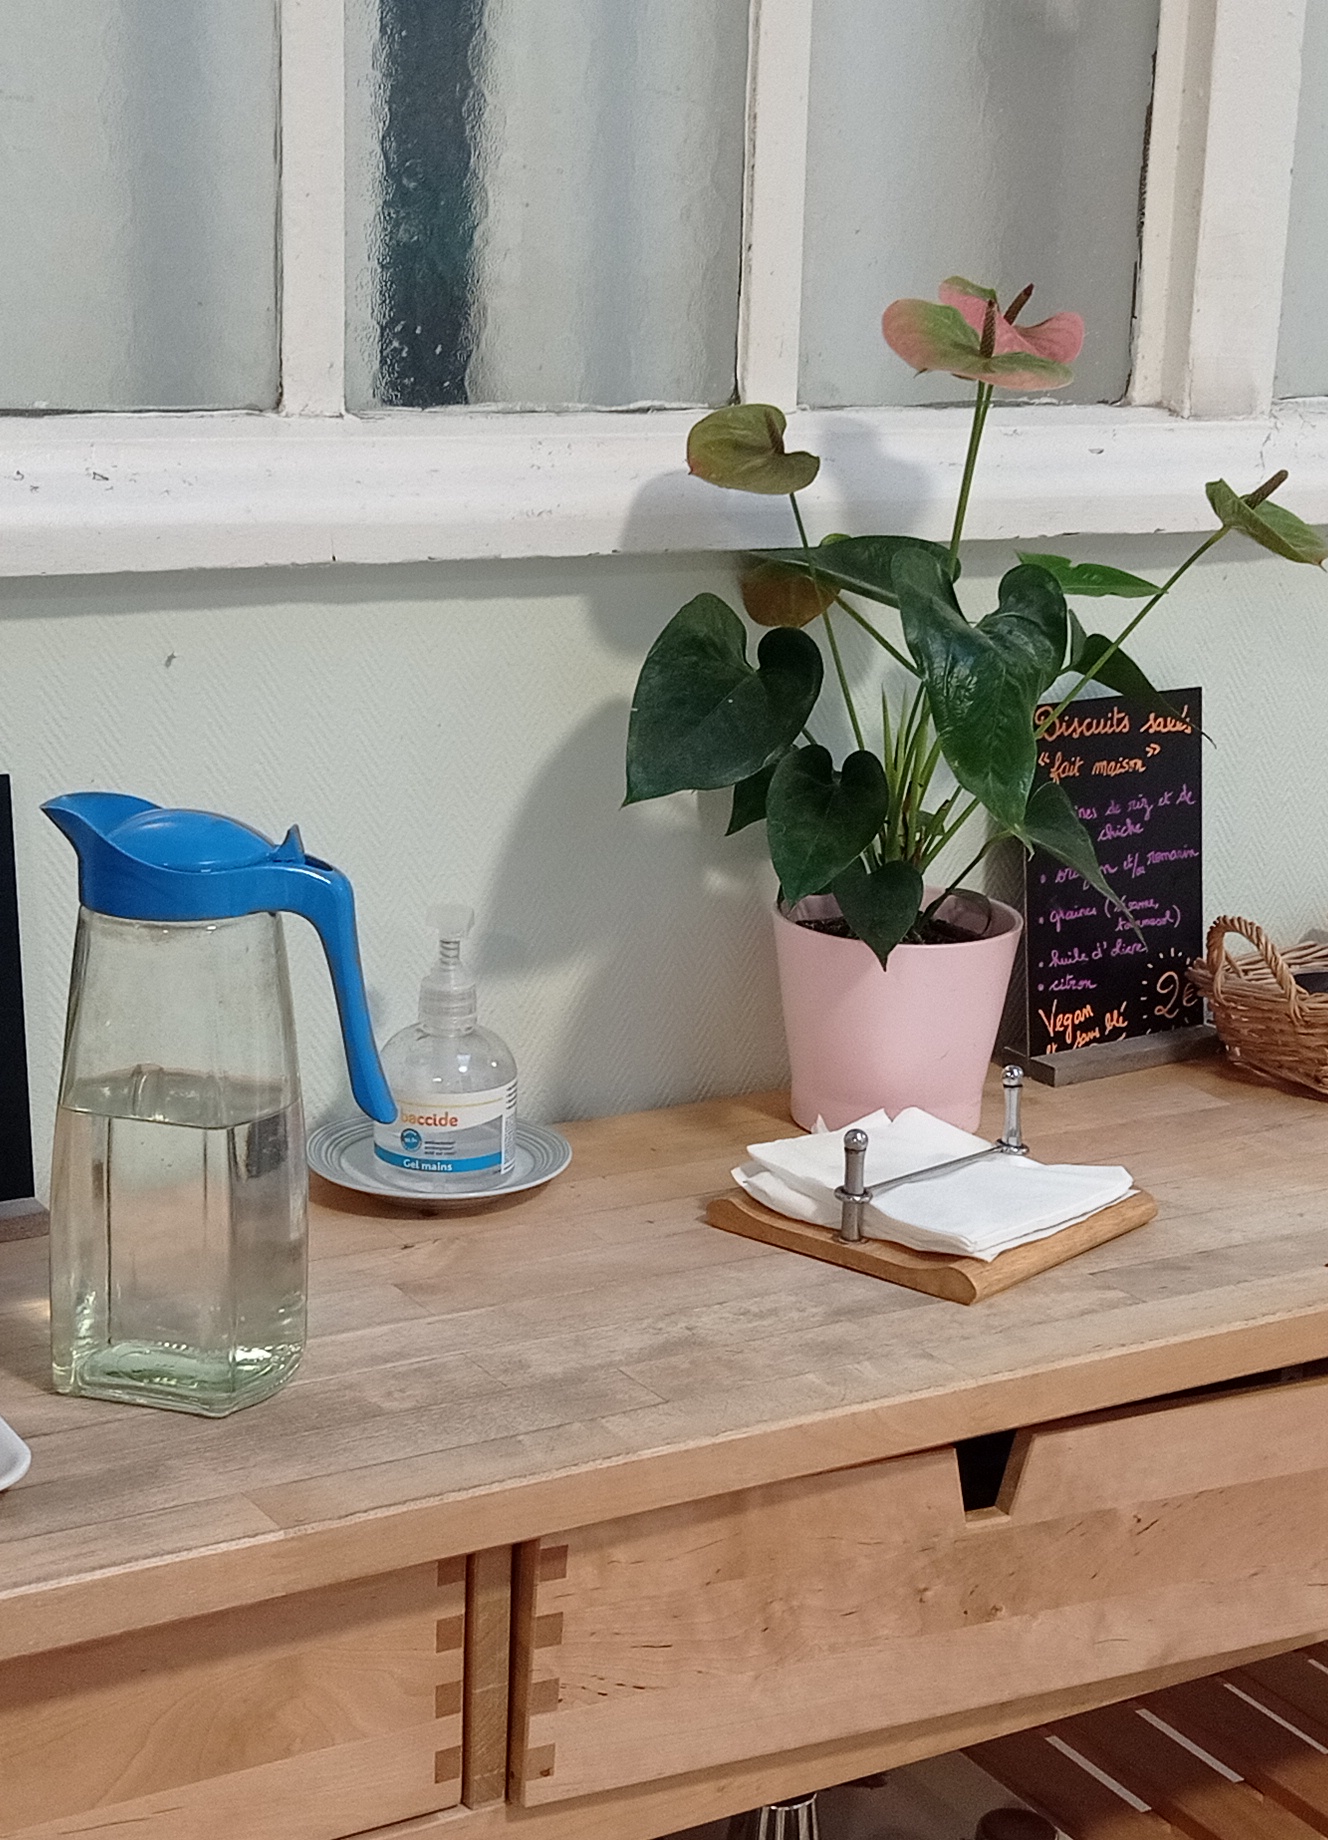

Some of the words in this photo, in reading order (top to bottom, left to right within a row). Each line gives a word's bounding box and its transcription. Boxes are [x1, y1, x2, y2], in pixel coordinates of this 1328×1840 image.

[1034, 705, 1130, 742] Biscuits
[1105, 800, 1122, 816] de
[1158, 791, 1174, 806] et
[1176, 784, 1196, 805] de
[1097, 818, 1144, 842] chiche
[1147, 843, 1200, 866] romarin
[1050, 904, 1097, 933] graines
[1049, 948, 1089, 968] huile
[1049, 974, 1097, 992] citron
[1038, 999, 1094, 1044] Vegan
[1104, 1001, 1128, 1036] blé
[403, 1158, 419, 1170] Gel
[421, 1161, 453, 1172] mains
